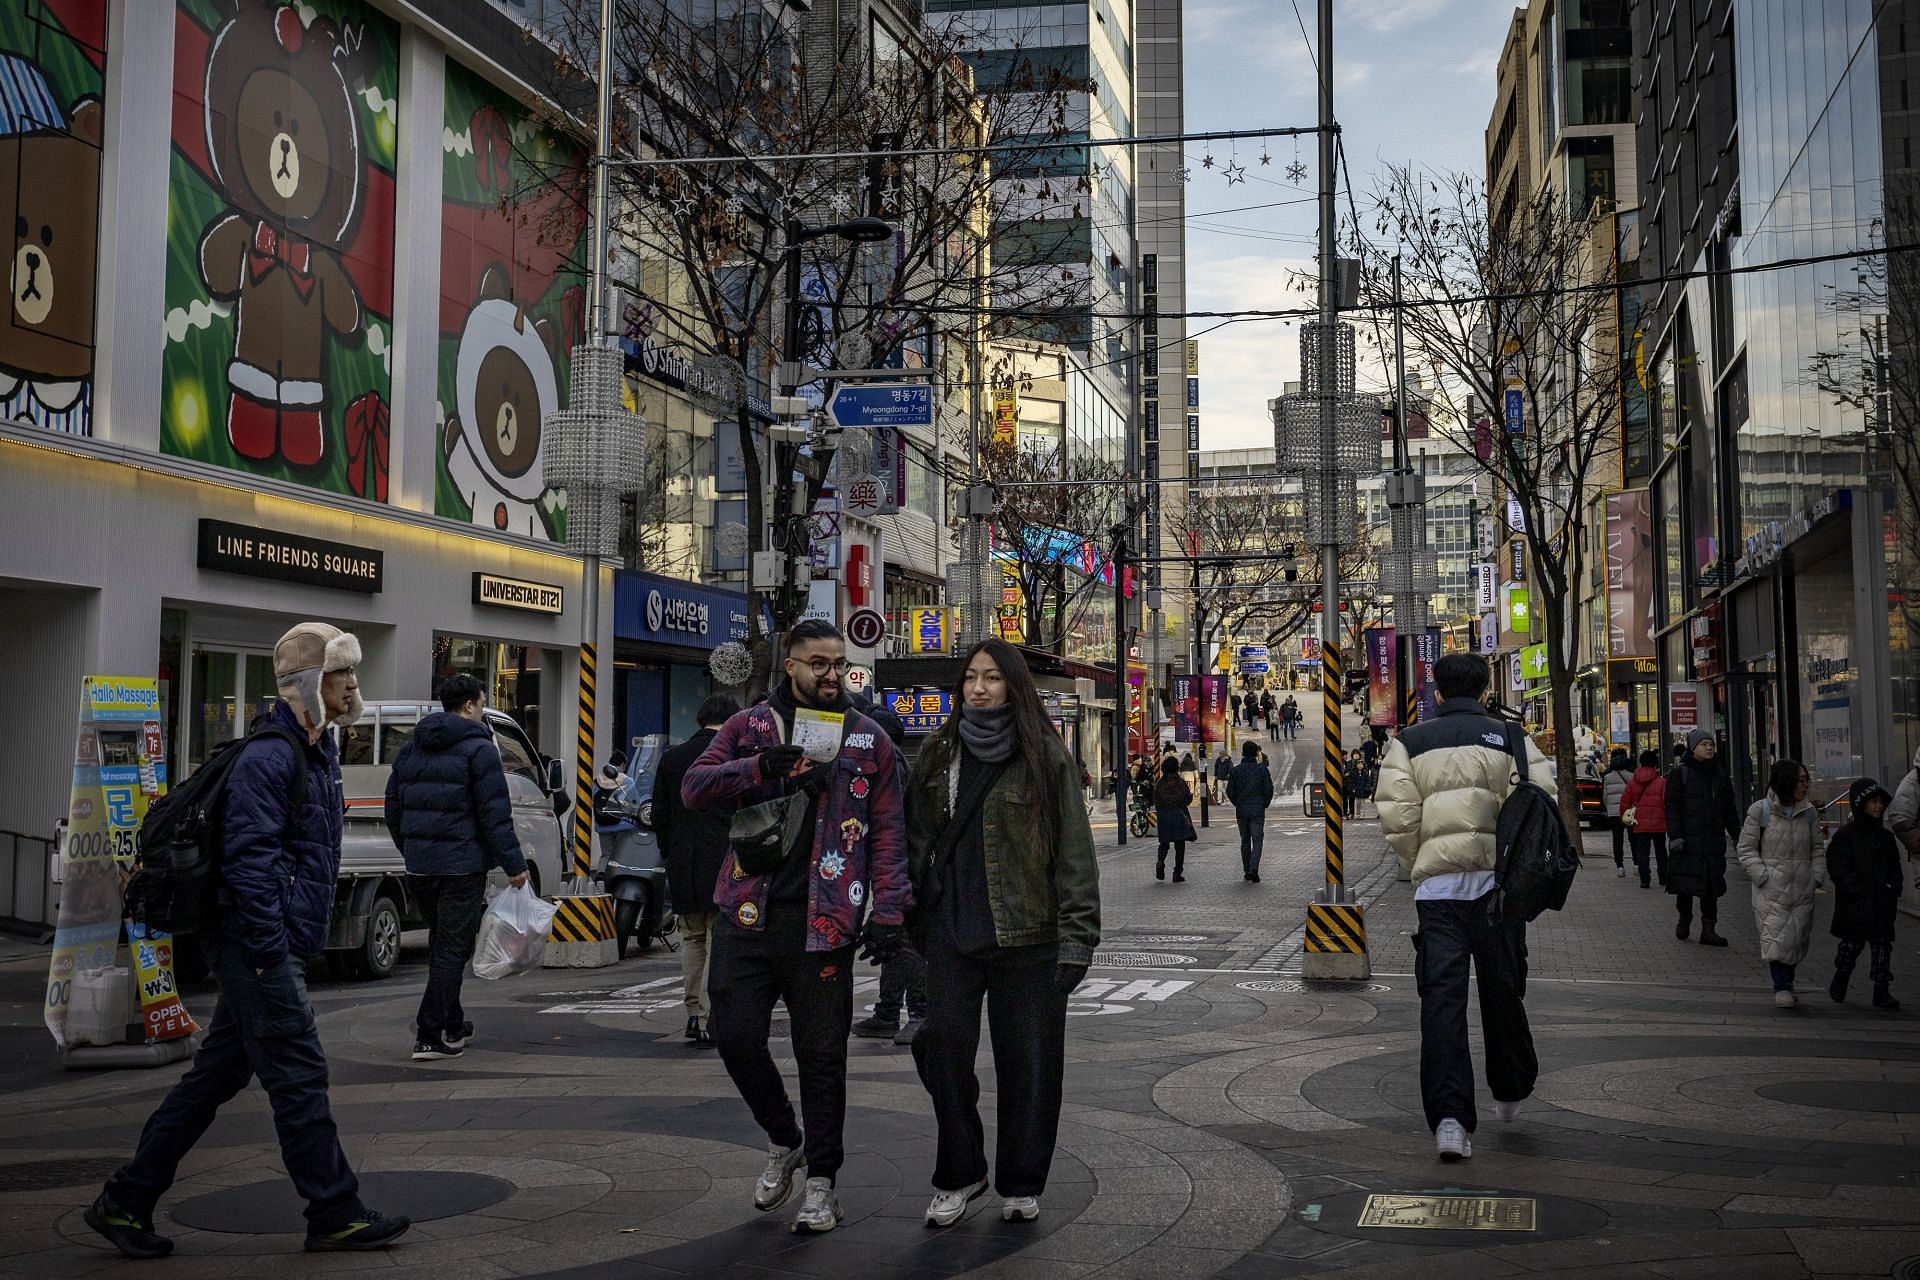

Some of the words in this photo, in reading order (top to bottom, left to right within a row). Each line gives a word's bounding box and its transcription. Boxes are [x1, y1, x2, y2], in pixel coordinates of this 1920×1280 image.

[892, 389, 927, 402] 명동7길
[862, 405, 908, 414] Myeongdong
[910, 404, 927, 413] 7-gil
[849, 480, 877, 509] 藥
[217, 535, 253, 558] LINE
[258, 542, 319, 569] FRIENDS
[324, 553, 376, 579] SQUARE
[483, 579, 539, 606] UNIVERSTAR
[540, 589, 559, 608] BT21
[1482, 565, 1491, 604] SUSHIRO
[664, 597, 709, 635] 신한은행
[918, 610, 942, 652] 상품권
[1485, 635, 1493, 648] CU
[849, 672, 865, 688] 약
[116, 685, 157, 708] Massage
[892, 694, 954, 715] 상품
[148, 736, 158, 752] 7F
[844, 738, 875, 751] PARK
[110, 773, 137, 782] massage
[106, 789, 138, 827] 足
[150, 1002, 185, 1022] OPEN
